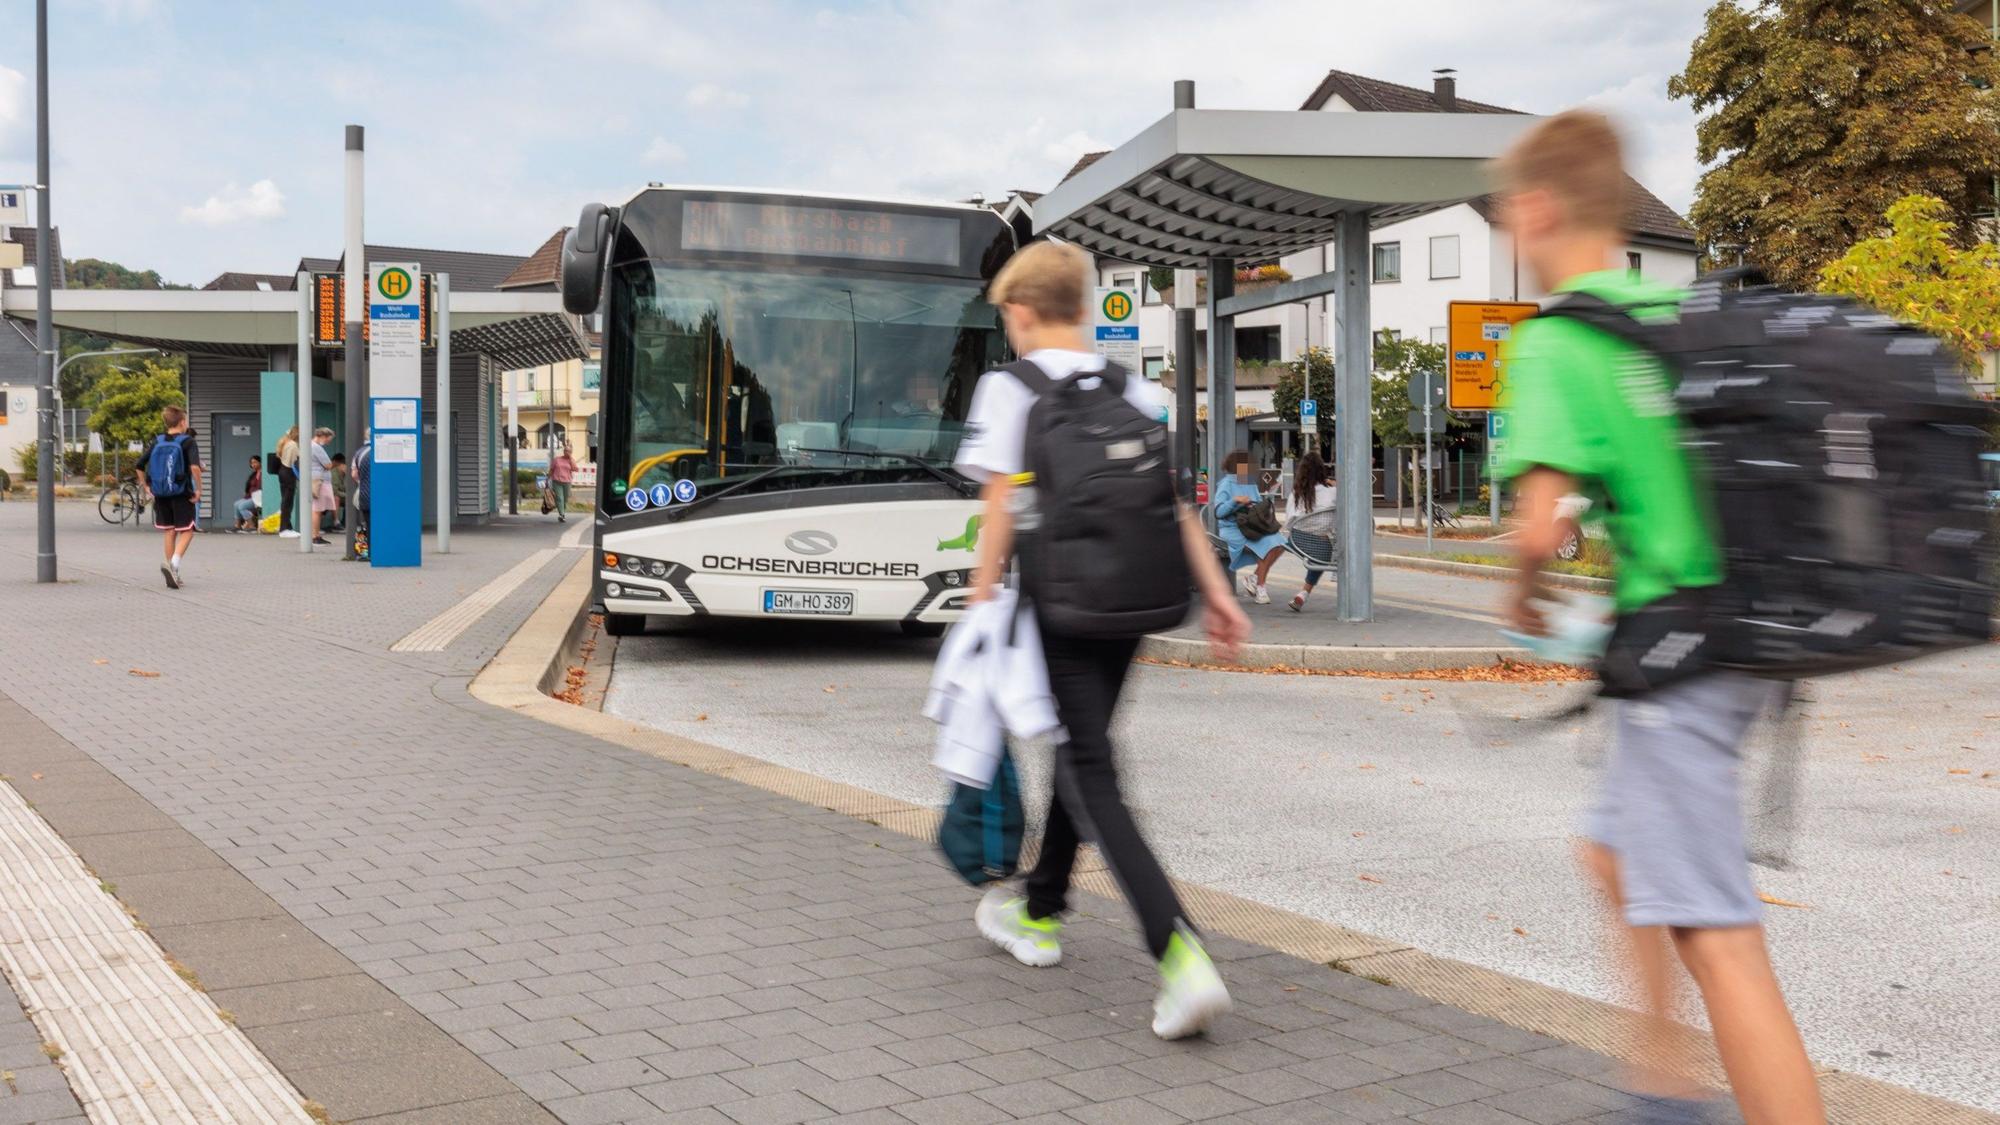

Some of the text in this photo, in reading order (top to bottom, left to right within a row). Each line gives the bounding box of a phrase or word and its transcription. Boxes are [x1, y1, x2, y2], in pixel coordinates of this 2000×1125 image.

[1304, 402, 1313, 415] P
[702, 555, 919, 577] OCHSENBRÜCHER
[774, 593, 850, 609] GM HO 389
